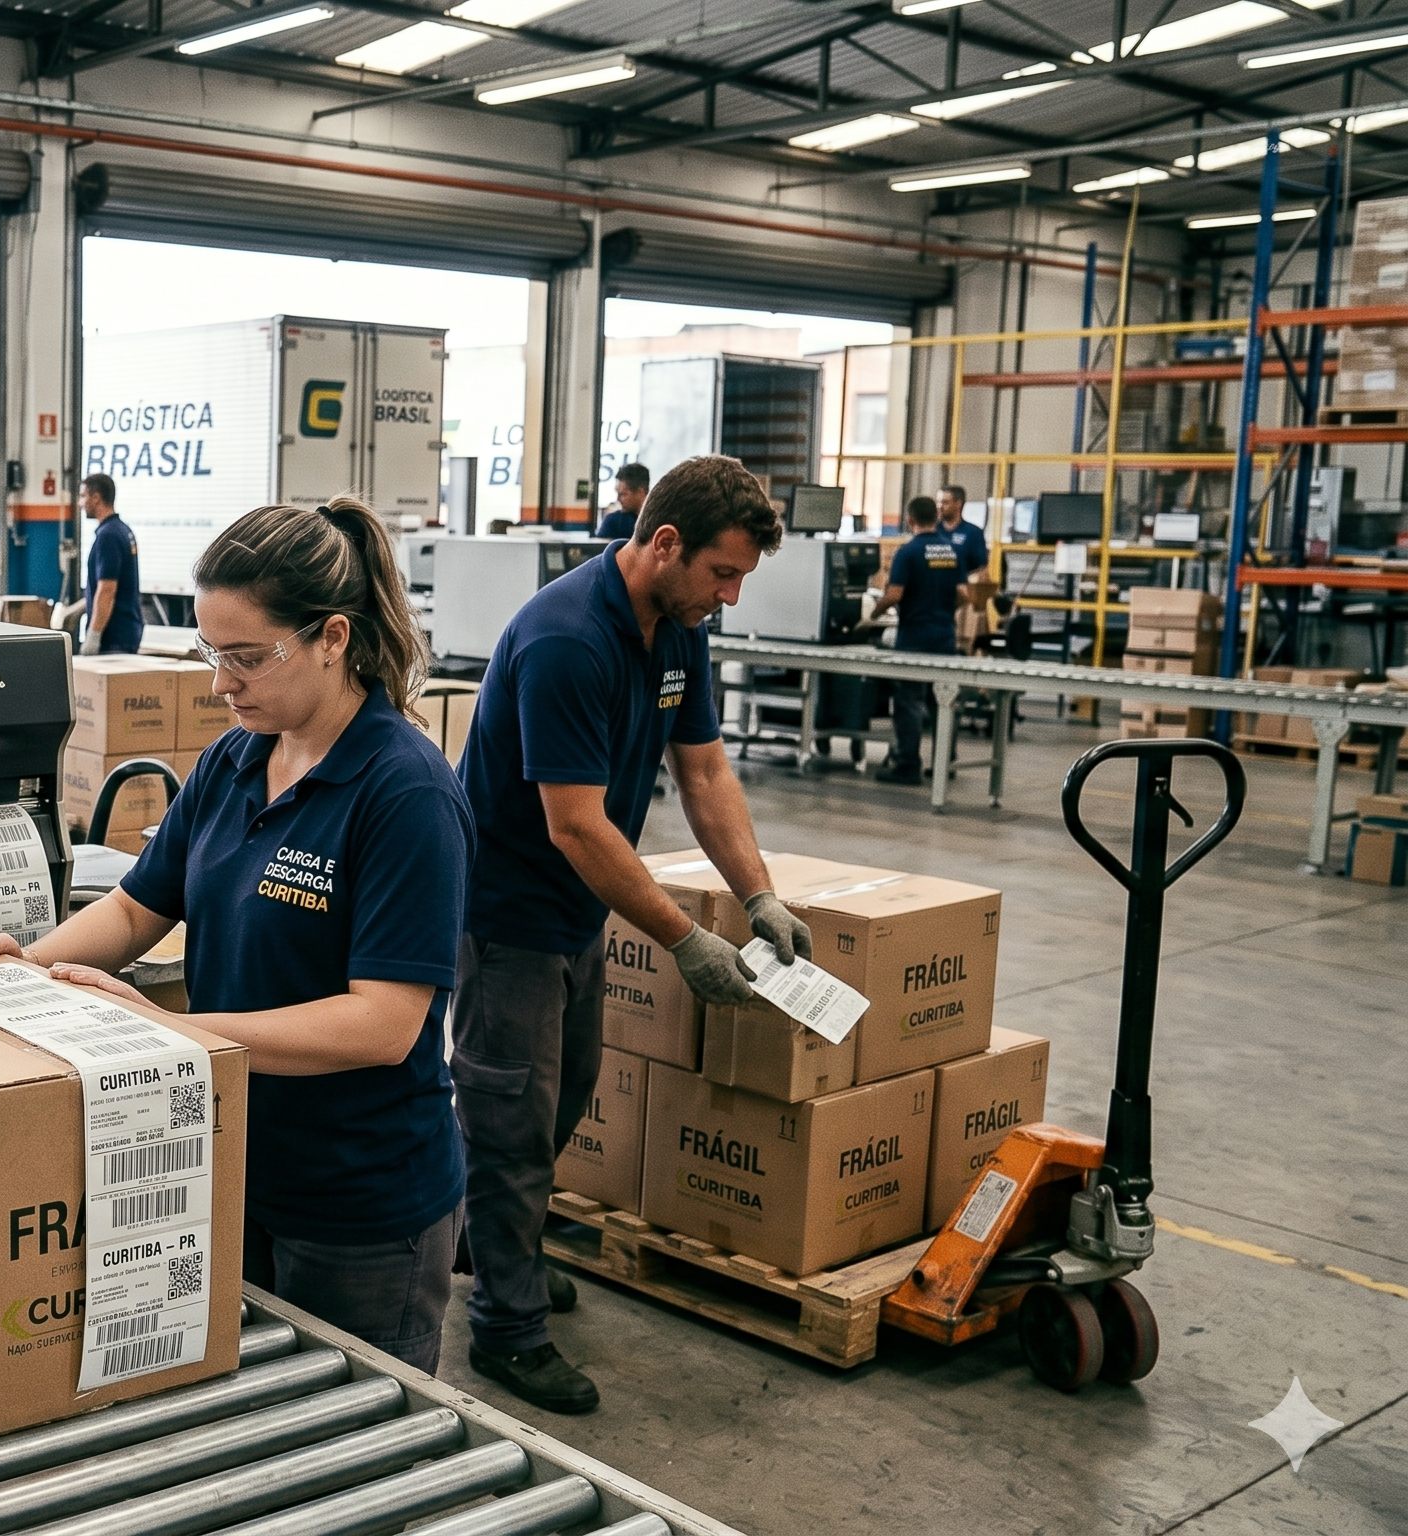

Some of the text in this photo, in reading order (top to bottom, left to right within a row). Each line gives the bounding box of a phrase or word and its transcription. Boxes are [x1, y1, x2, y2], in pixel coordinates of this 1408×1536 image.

[375, 388, 434, 404] LOGÍSTICA
[88, 399, 213, 434] LOGÍSTICA
[374, 405, 432, 424] BRASIL
[87, 440, 212, 478] BRASIL
[276, 847, 336, 874] CARGA E
[264, 862, 334, 893] DESCARGA
[257, 879, 328, 912] CURITIBA
[605, 931, 658, 974] ÁGIL
[903, 954, 967, 994] FRÁGIL
[604, 982, 655, 1009] RITIBA
[909, 1000, 965, 1027] CURITIBA
[100, 1068, 161, 1092] CURITIBA
[177, 1061, 195, 1079] PR
[964, 1099, 1022, 1140] FRÁGIL
[571, 1133, 604, 1156] TIBA
[679, 1125, 766, 1177] FRÁGIL
[839, 1135, 903, 1179] FRÁGIL
[687, 1173, 763, 1211] CURITIBA
[103, 1241, 162, 1267] CURITIBA
[179, 1234, 196, 1250] PR
